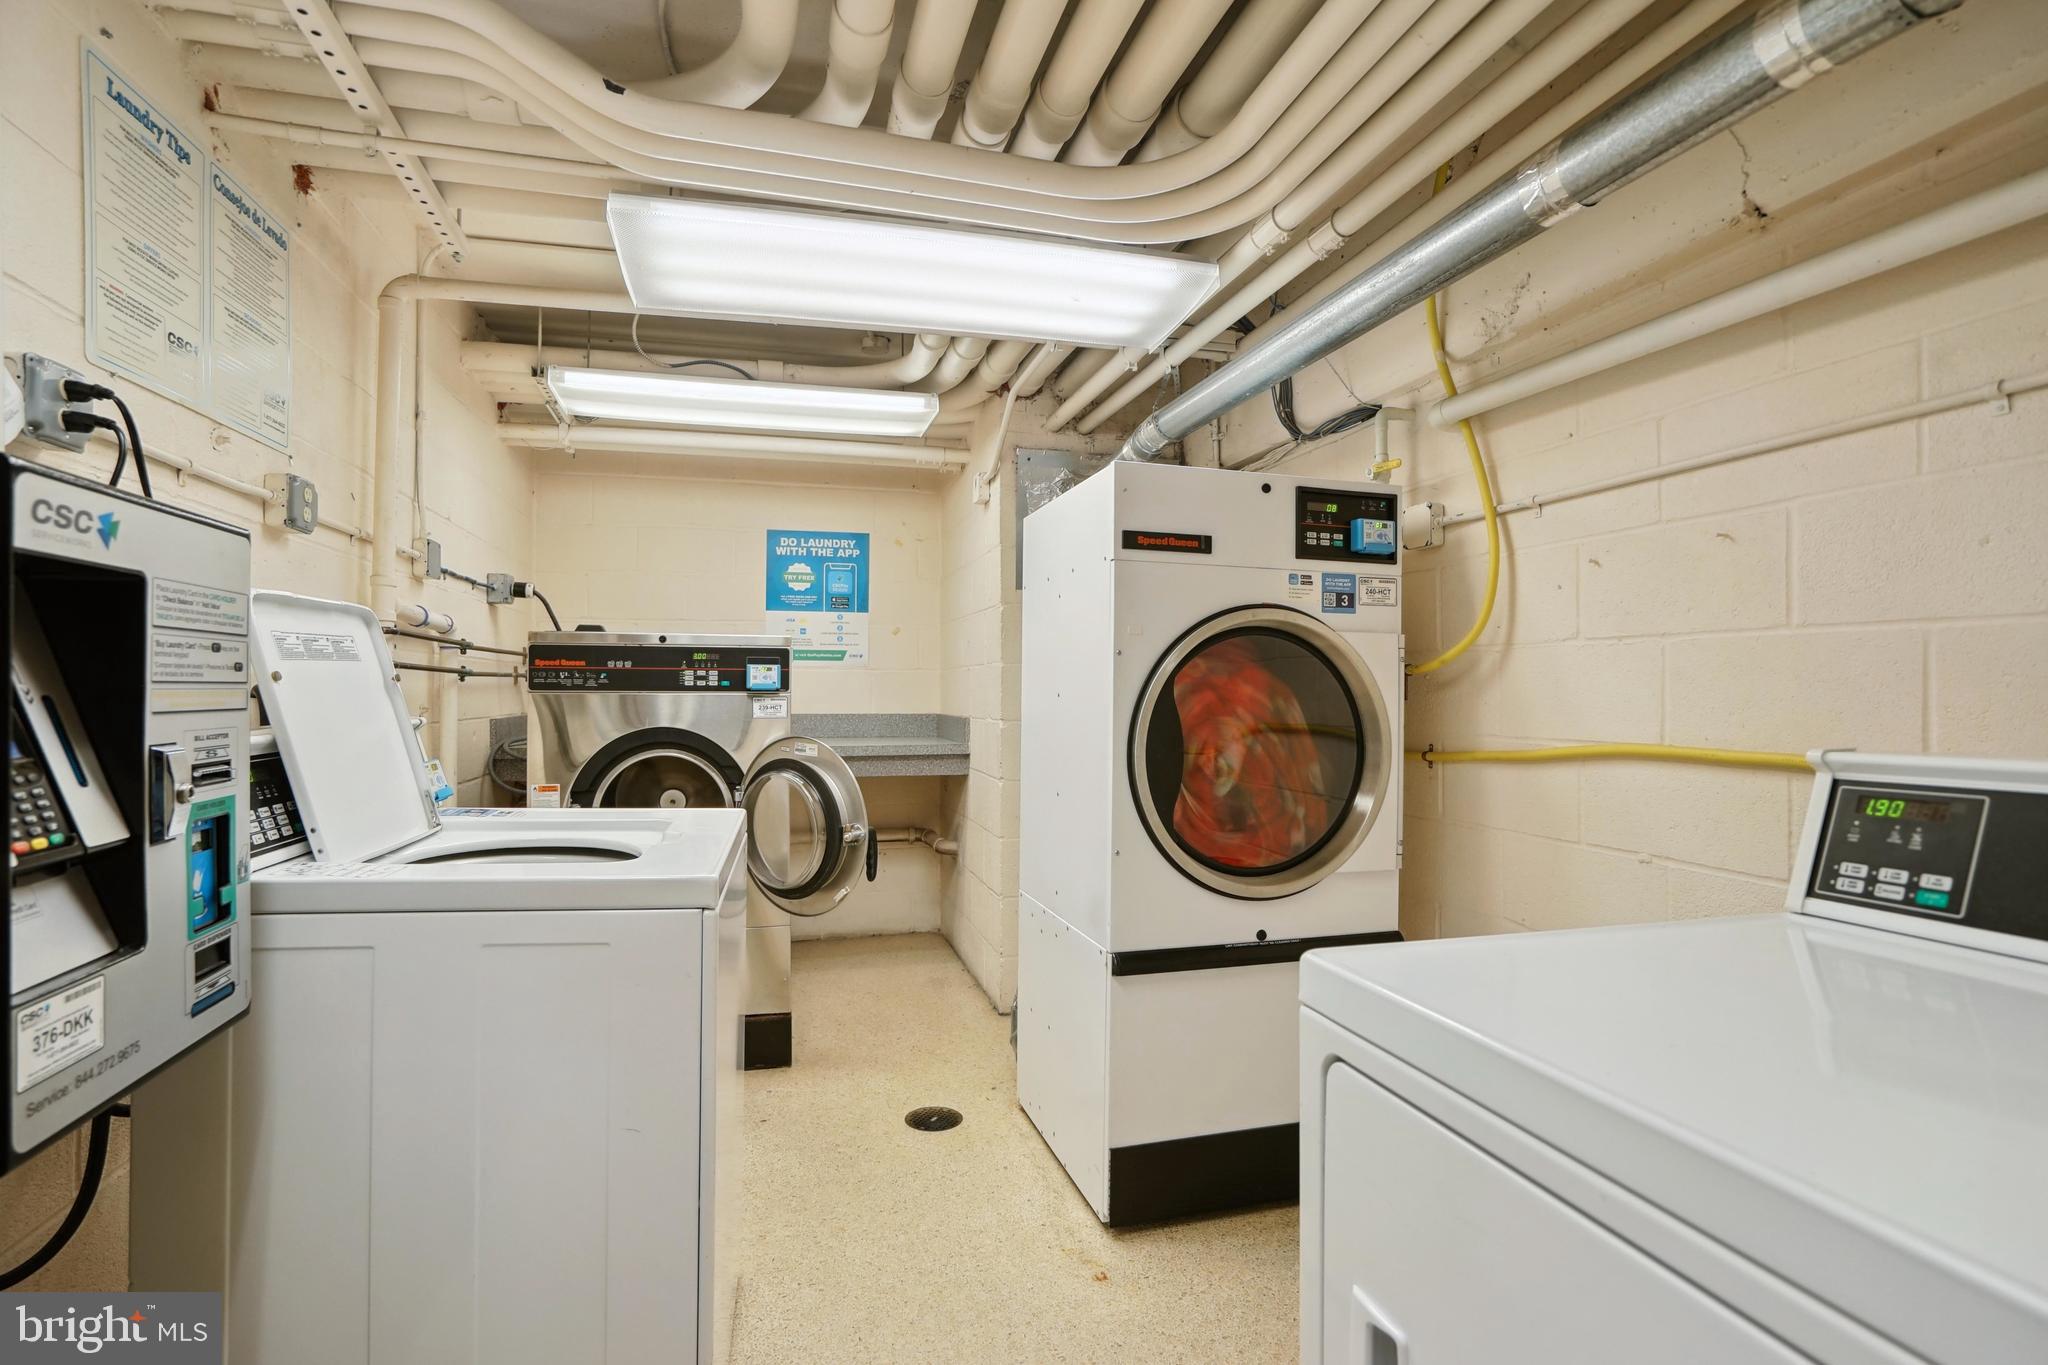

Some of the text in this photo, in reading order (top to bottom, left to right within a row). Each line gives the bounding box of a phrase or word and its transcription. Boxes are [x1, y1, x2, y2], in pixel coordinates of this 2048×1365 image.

[107, 76, 163, 144] Laundry
[166, 128, 190, 165] Tips
[252, 208, 261, 227] de
[167, 331, 193, 353] CSC
[1326, 503, 1338, 513] 08
[31, 499, 93, 534] CSC
[780, 537, 856, 549] DO LAUNDRY
[1137, 535, 1199, 547] Speed Queen
[776, 546, 860, 558] WITH THE APP
[1365, 588, 1391, 596] 240-HCT
[1341, 595, 1349, 606] 3
[535, 659, 565, 667] Speed
[33, 1009, 94, 1052] 376-DKK
[26, 1086, 69, 1118] Service:
